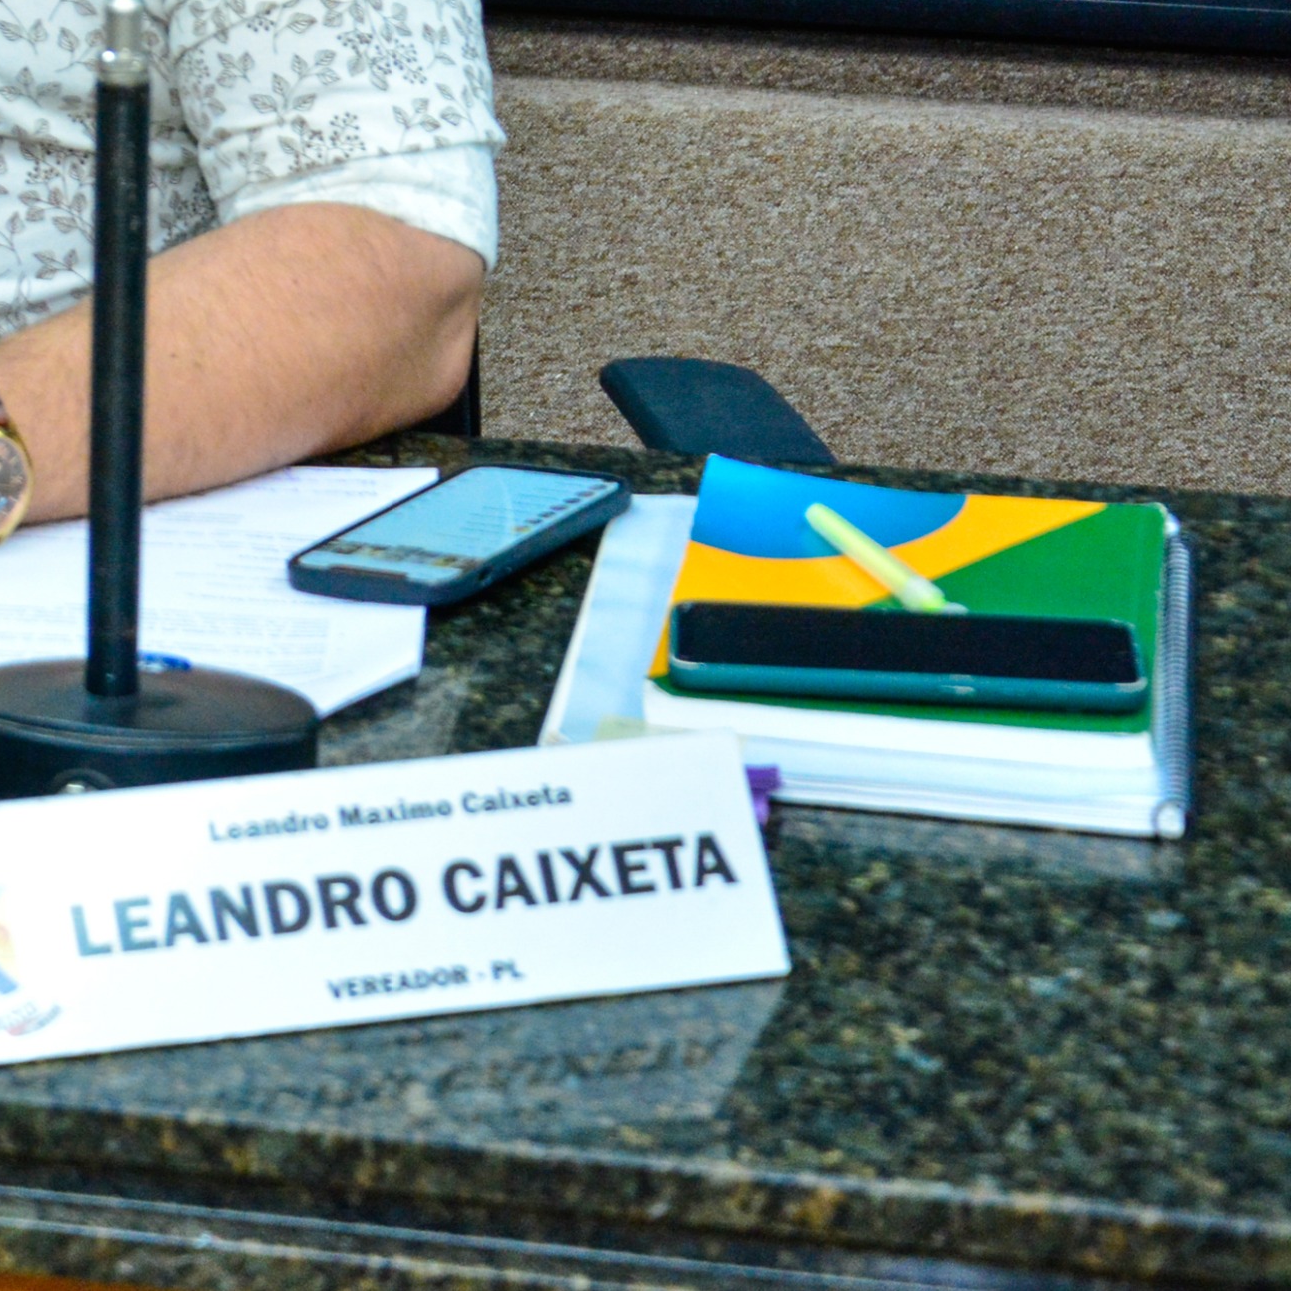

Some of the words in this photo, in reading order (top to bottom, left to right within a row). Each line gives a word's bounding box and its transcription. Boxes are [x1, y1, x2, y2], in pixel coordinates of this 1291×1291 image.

[208, 812, 330, 842] Leandro
[337, 798, 454, 828] Maximo
[461, 784, 573, 815] Caixeta
[70, 866, 420, 957] LEANDRO
[441, 830, 741, 916] CAIXETA
[328, 965, 469, 999] VEREADOR
[491, 959, 523, 981] PL
